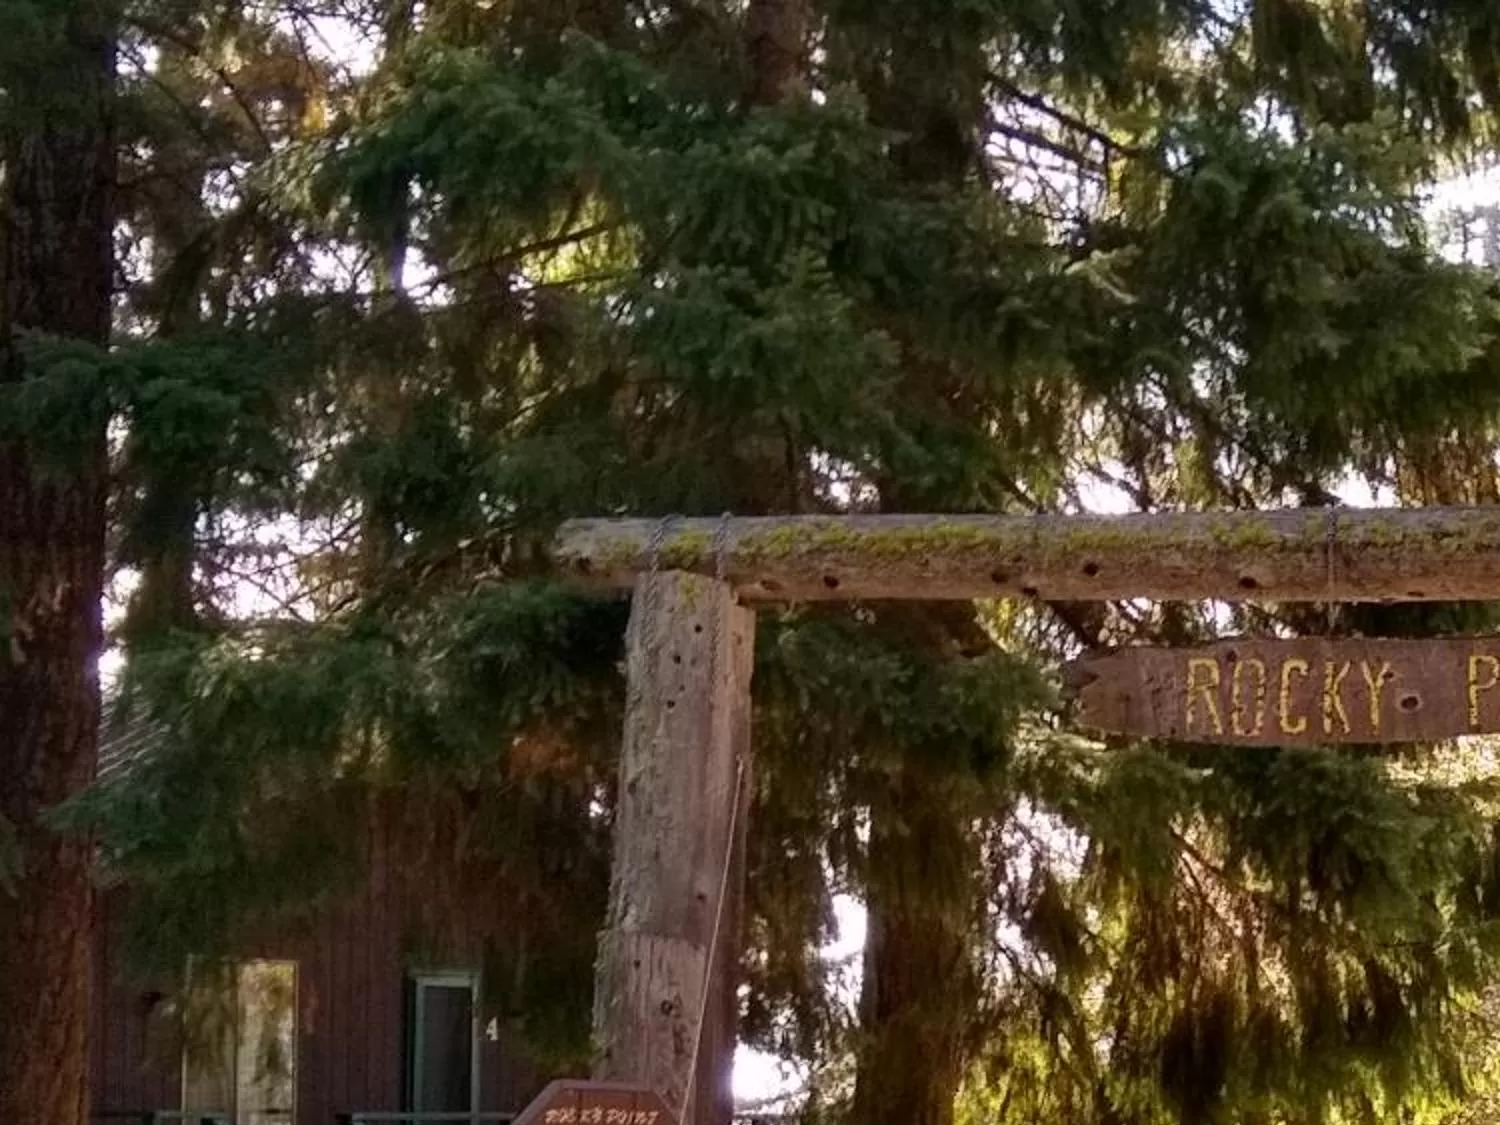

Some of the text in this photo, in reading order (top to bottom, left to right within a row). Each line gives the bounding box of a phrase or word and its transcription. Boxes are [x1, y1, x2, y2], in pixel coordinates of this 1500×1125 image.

[1185, 656, 1391, 738] ROCKY
[486, 1017, 498, 1041] 4
[545, 1106, 602, 1124] ROCKY
